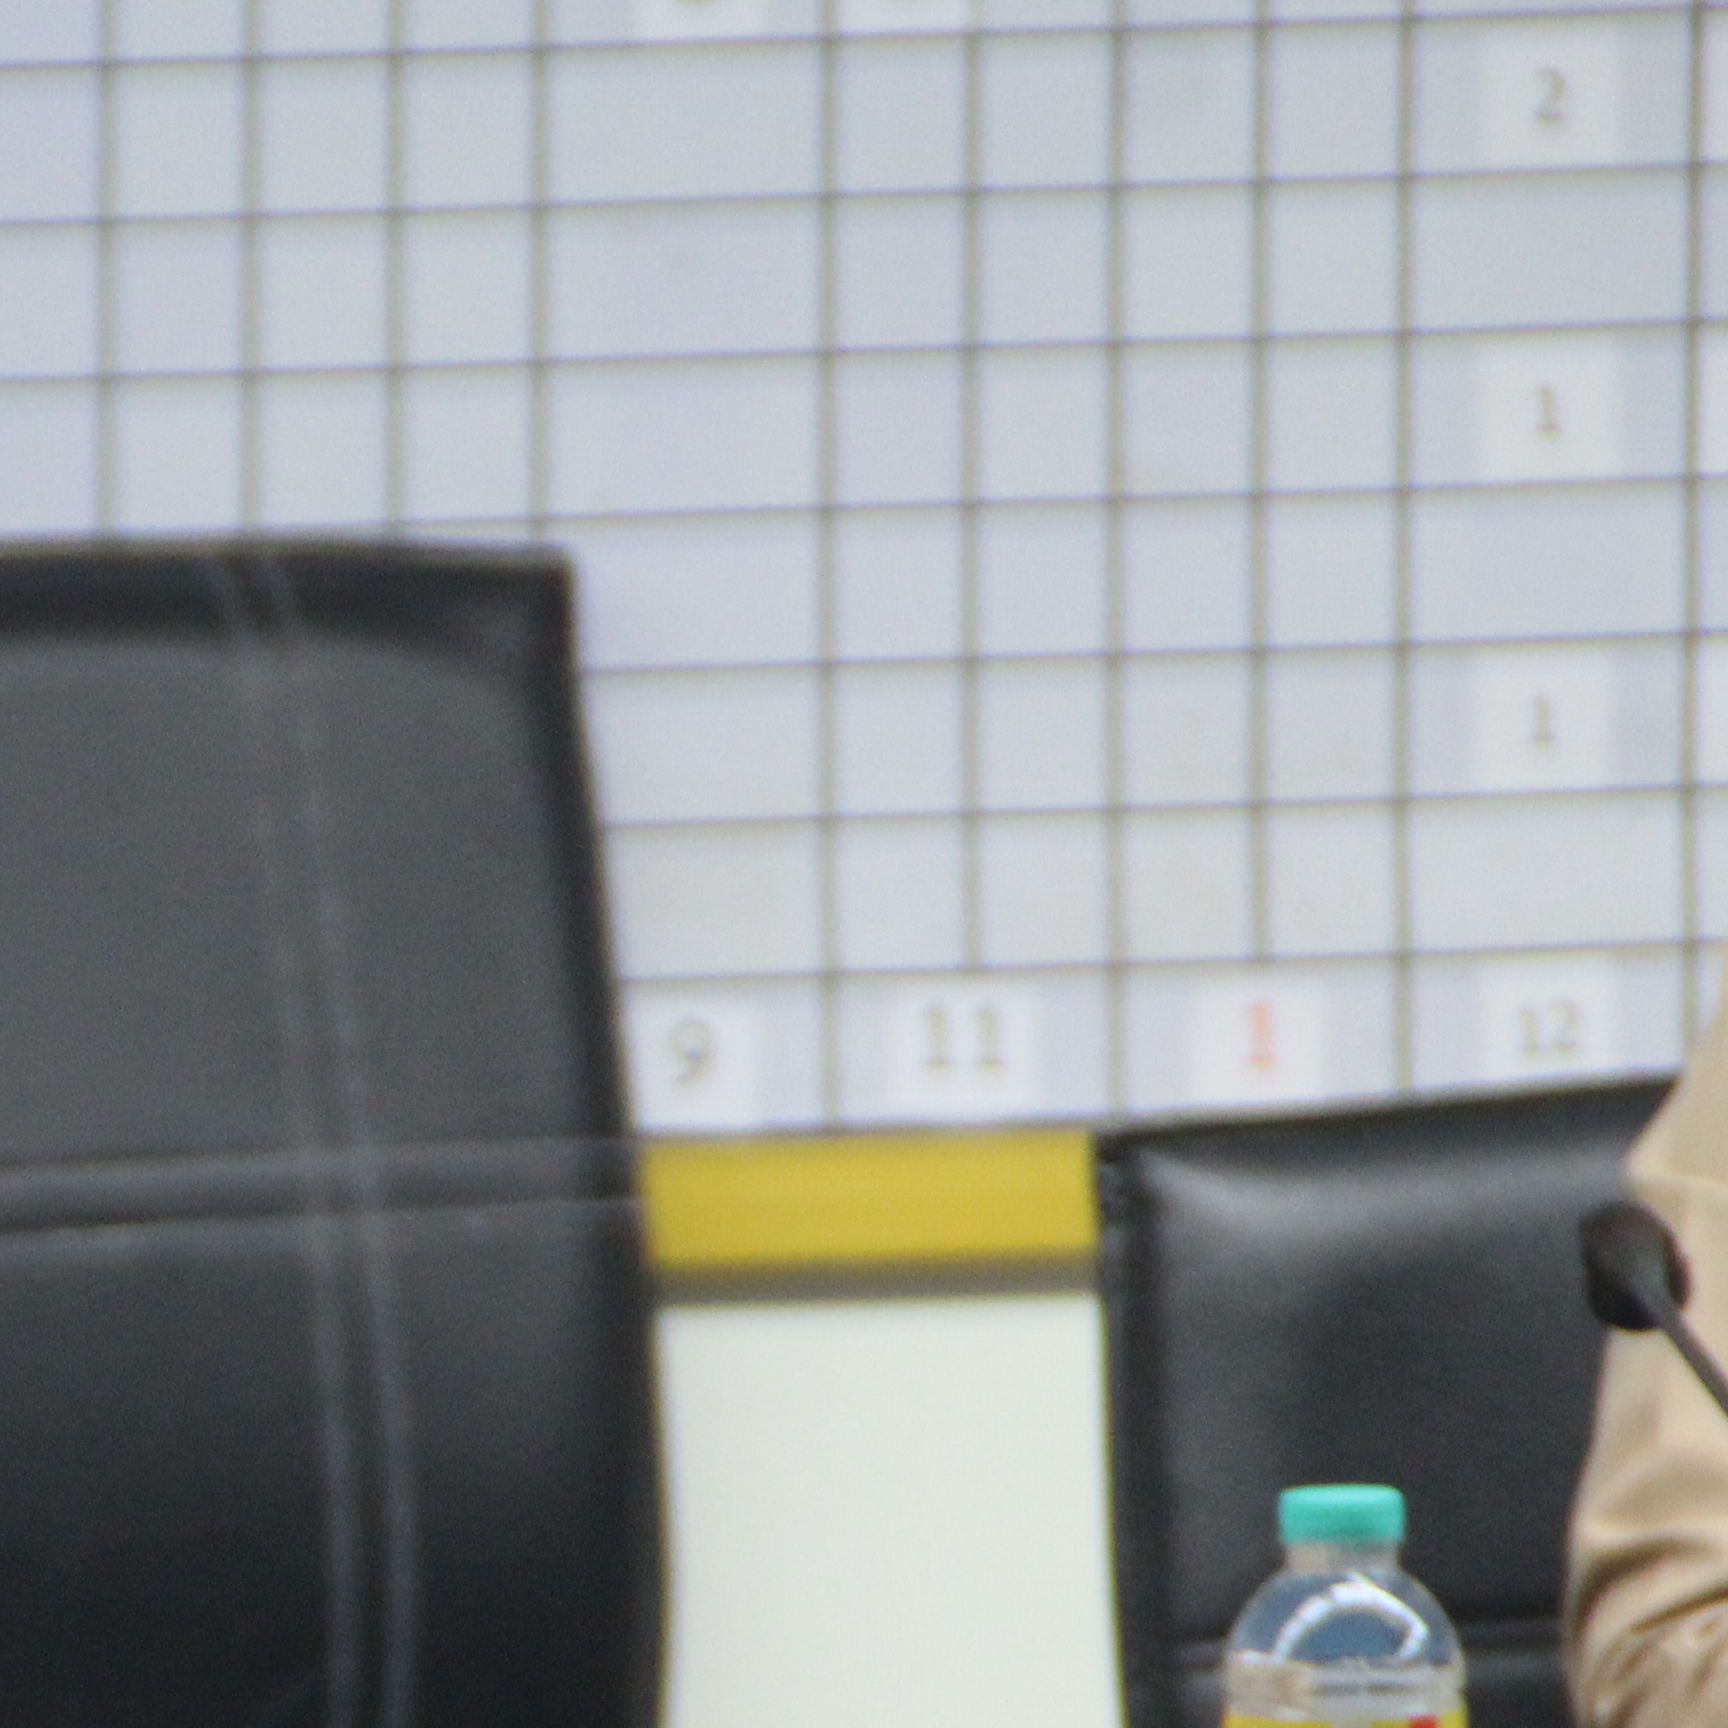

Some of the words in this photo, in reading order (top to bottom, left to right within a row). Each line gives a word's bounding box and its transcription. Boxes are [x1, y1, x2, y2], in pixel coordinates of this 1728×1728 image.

[923, 1005, 1003, 1073] 11
[1244, 1000, 1278, 1067] 1
[1518, 999, 1581, 1056] 12
